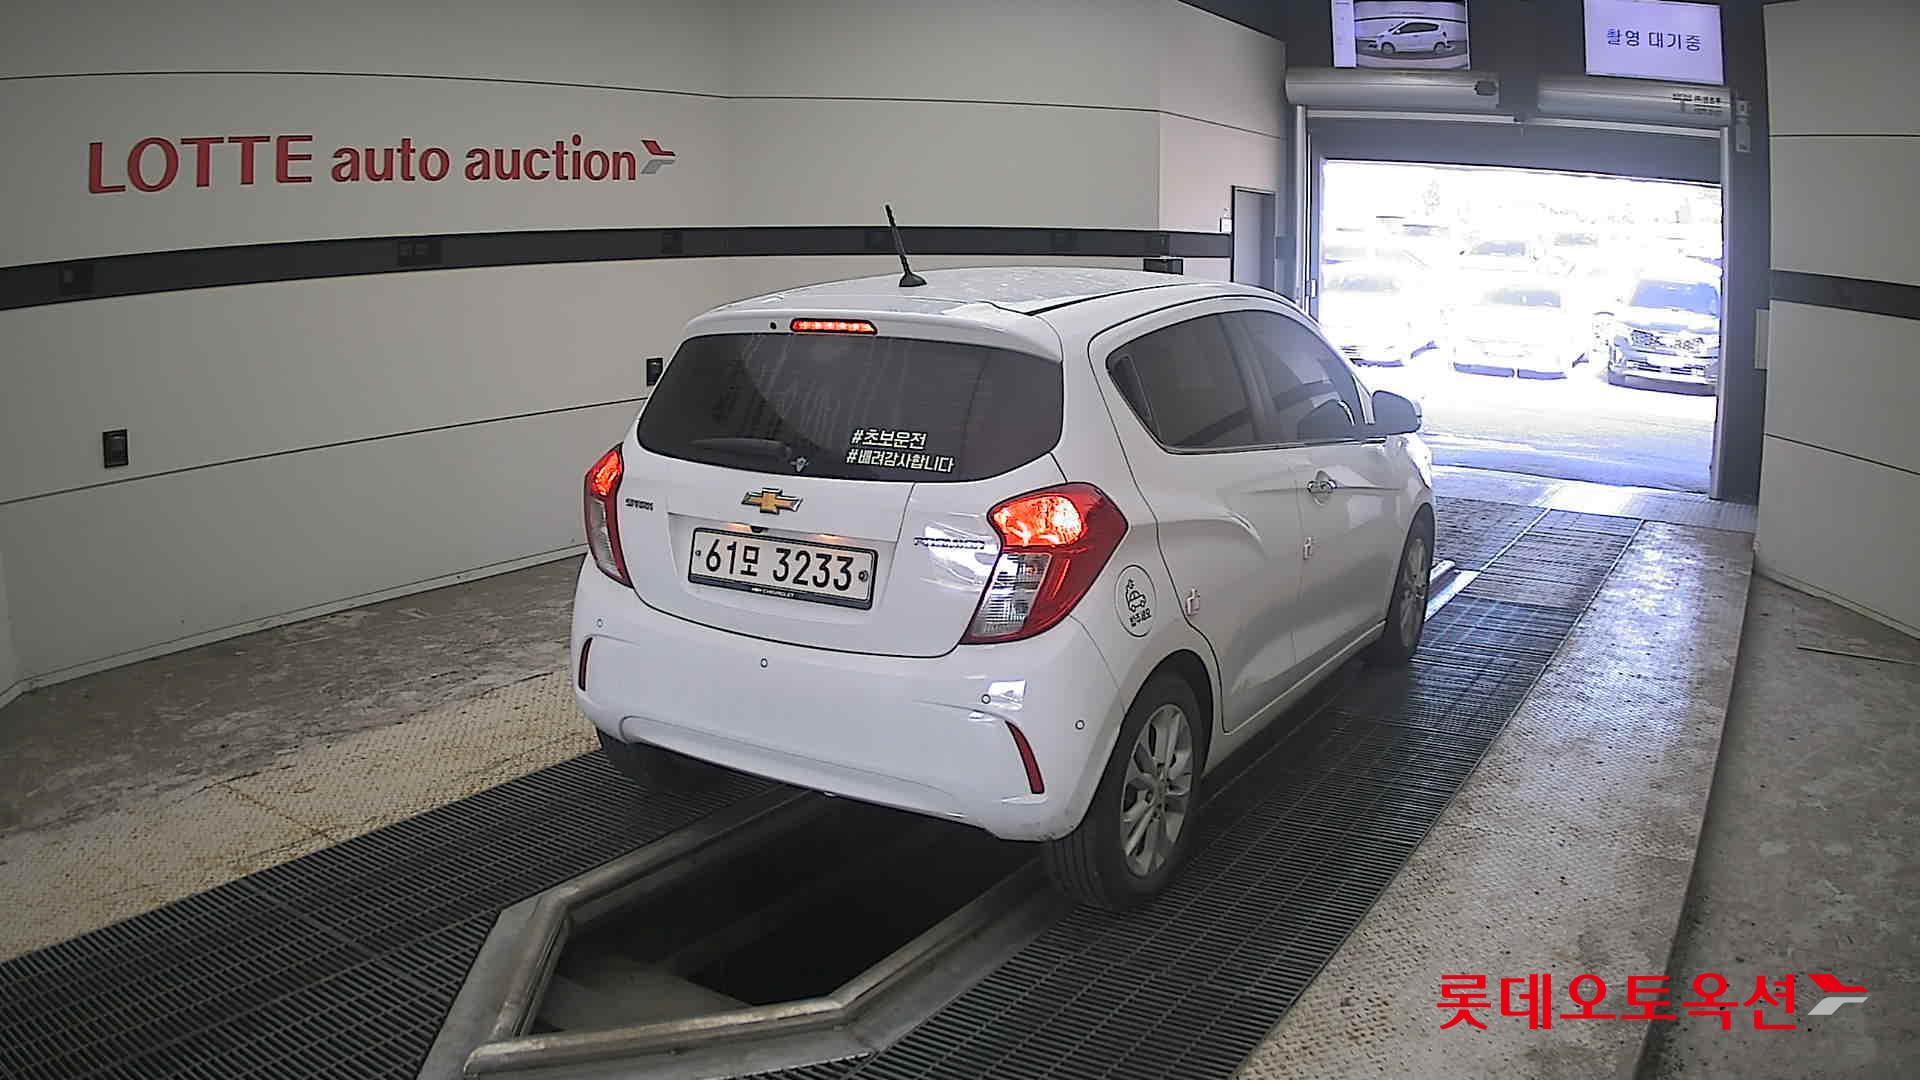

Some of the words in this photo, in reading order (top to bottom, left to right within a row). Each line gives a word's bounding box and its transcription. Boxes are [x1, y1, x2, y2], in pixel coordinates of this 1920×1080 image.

[1607, 28, 1640, 47] 촬영
[1648, 31, 1702, 52] 대기중
[88, 134, 313, 194] LOTTE
[331, 137, 450, 182] auto
[463, 133, 637, 181] auction
[851, 428, 927, 450] #초보운전
[846, 448, 955, 473] #배려감사합니다
[705, 538, 760, 577] 61모
[772, 547, 854, 591] 3233
